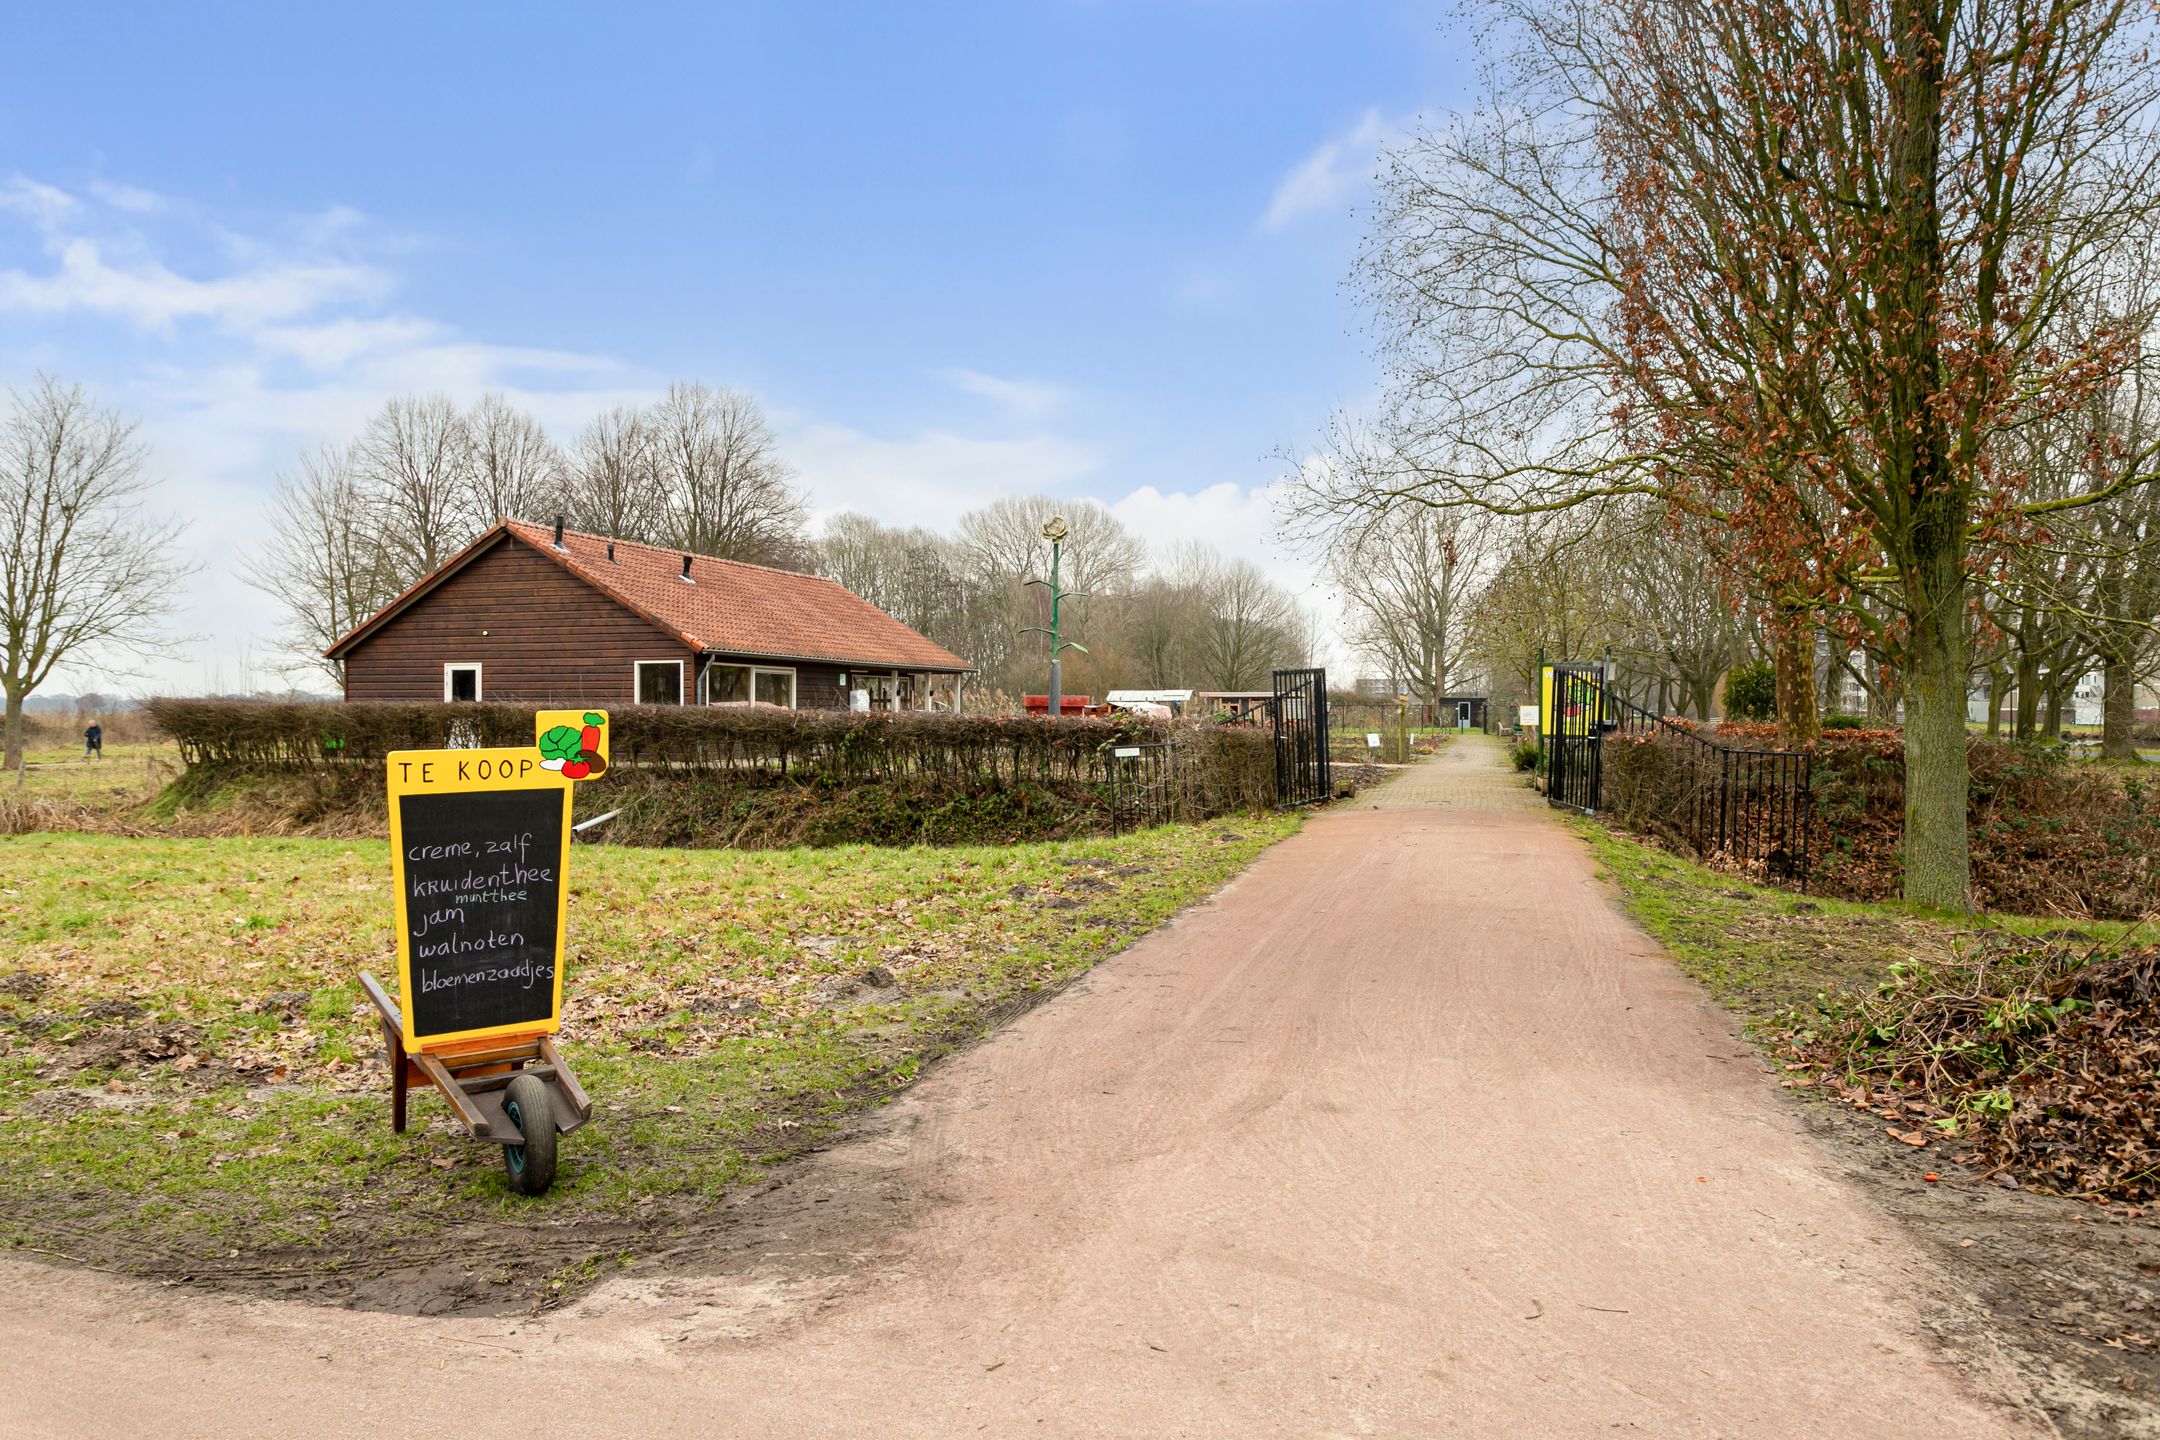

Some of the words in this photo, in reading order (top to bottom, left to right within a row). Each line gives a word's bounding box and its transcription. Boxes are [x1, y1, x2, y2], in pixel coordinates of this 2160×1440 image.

[398, 762, 435, 784] TE
[459, 760, 534, 781] KOOP
[408, 840, 480, 861] creme,
[486, 832, 533, 864] zalf
[413, 905, 465, 937] jam
[419, 930, 524, 959] walnoten
[421, 959, 555, 993] bloemenzaadjes
